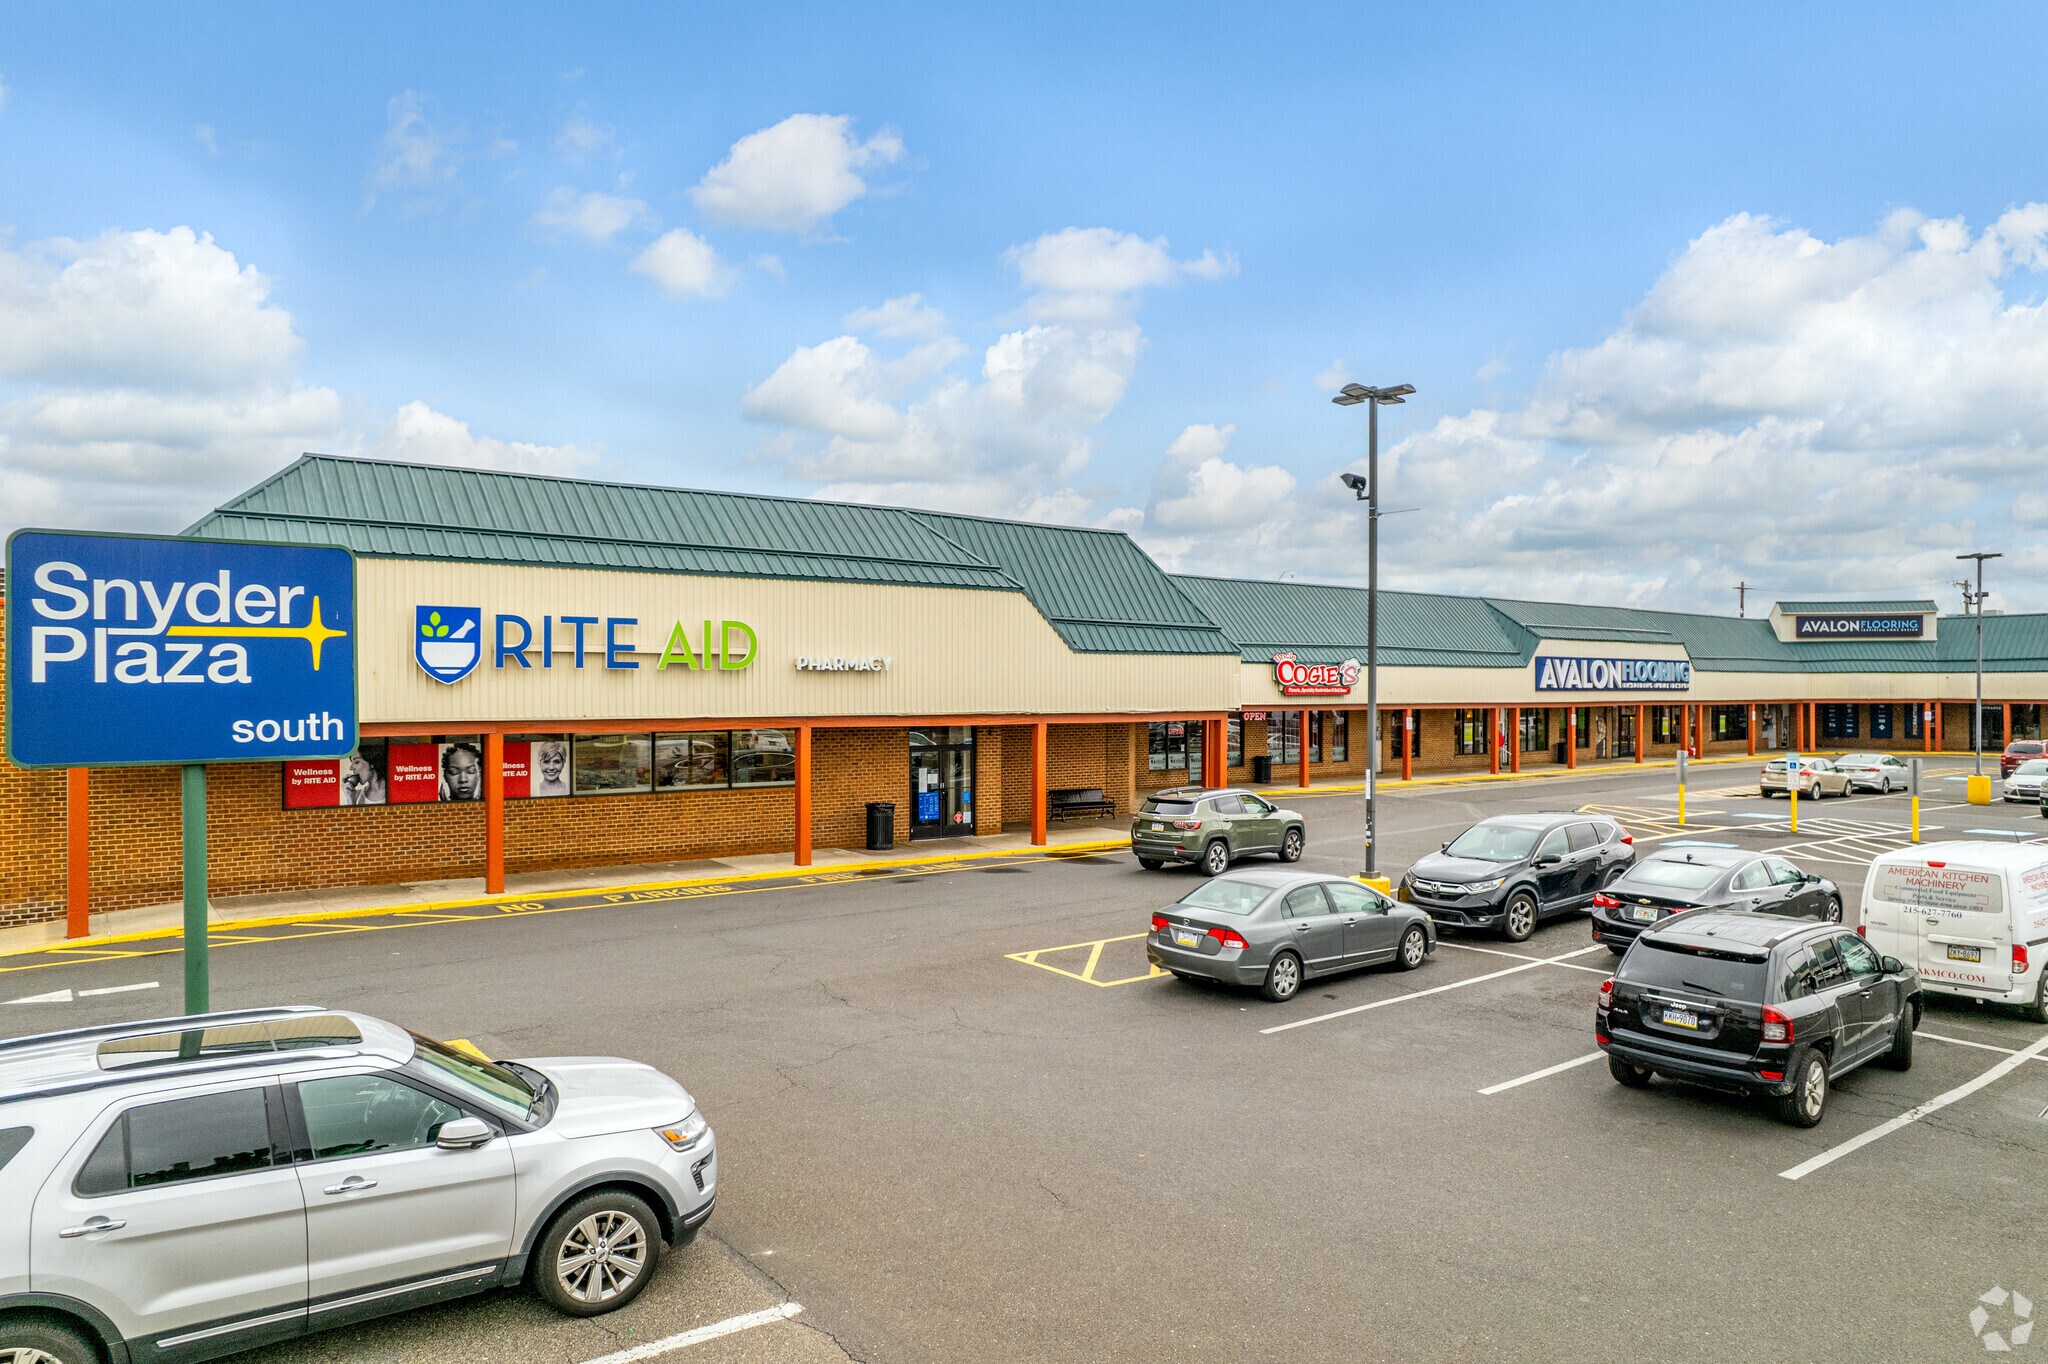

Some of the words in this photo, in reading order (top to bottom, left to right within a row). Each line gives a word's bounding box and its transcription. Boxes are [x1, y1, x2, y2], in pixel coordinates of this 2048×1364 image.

[31, 561, 305, 635] Snyder
[1801, 620, 1860, 632] AVALON
[1860, 620, 1918, 629] FLOORING
[494, 613, 640, 670] RITE
[656, 618, 758, 671] AID
[31, 626, 252, 684] Plaza
[794, 655, 894, 672] PHARMACY
[1539, 658, 1622, 689] AVALON
[1621, 661, 1690, 683] FLOORING
[1243, 712, 1266, 721] OPEN
[232, 711, 344, 743] south
[293, 768, 333, 776] Wellness
[395, 765, 433, 773] Wellness
[291, 778, 302, 786] by
[304, 777, 322, 785] RITE
[394, 774, 404, 782] by
[1888, 867, 1939, 878] AMERICAN
[1942, 871, 1989, 883] KITCHEN
[1906, 878, 1966, 890] MACHINERY
[495, 902, 545, 913] NO
[603, 884, 733, 903] PARKING
[1903, 906, 1962, 918] 215-627-7760
[1671, 1001, 1687, 1010] Jeep
